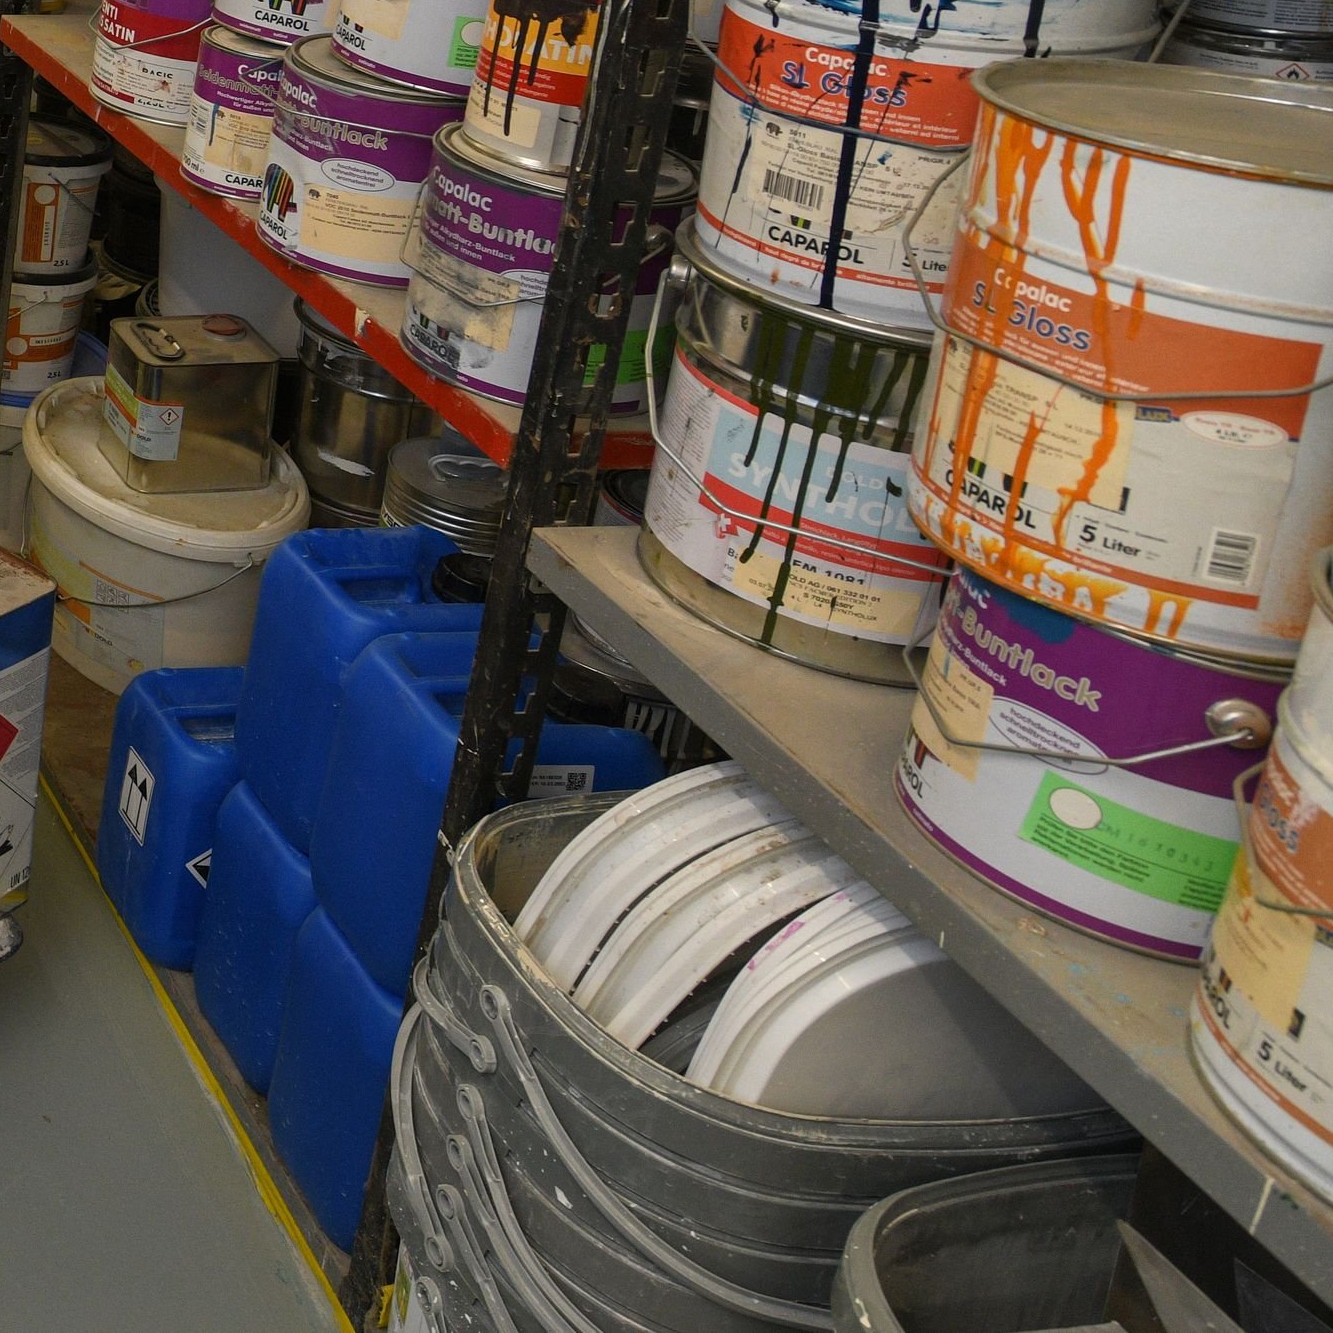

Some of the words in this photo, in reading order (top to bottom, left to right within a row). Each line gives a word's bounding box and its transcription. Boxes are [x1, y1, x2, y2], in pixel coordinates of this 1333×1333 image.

[254, 9, 310, 32] CAPAROL
[1078, 523, 1097, 543] 5
[1102, 534, 1142, 558] Liter
[1257, 1039, 1271, 1062] 5
